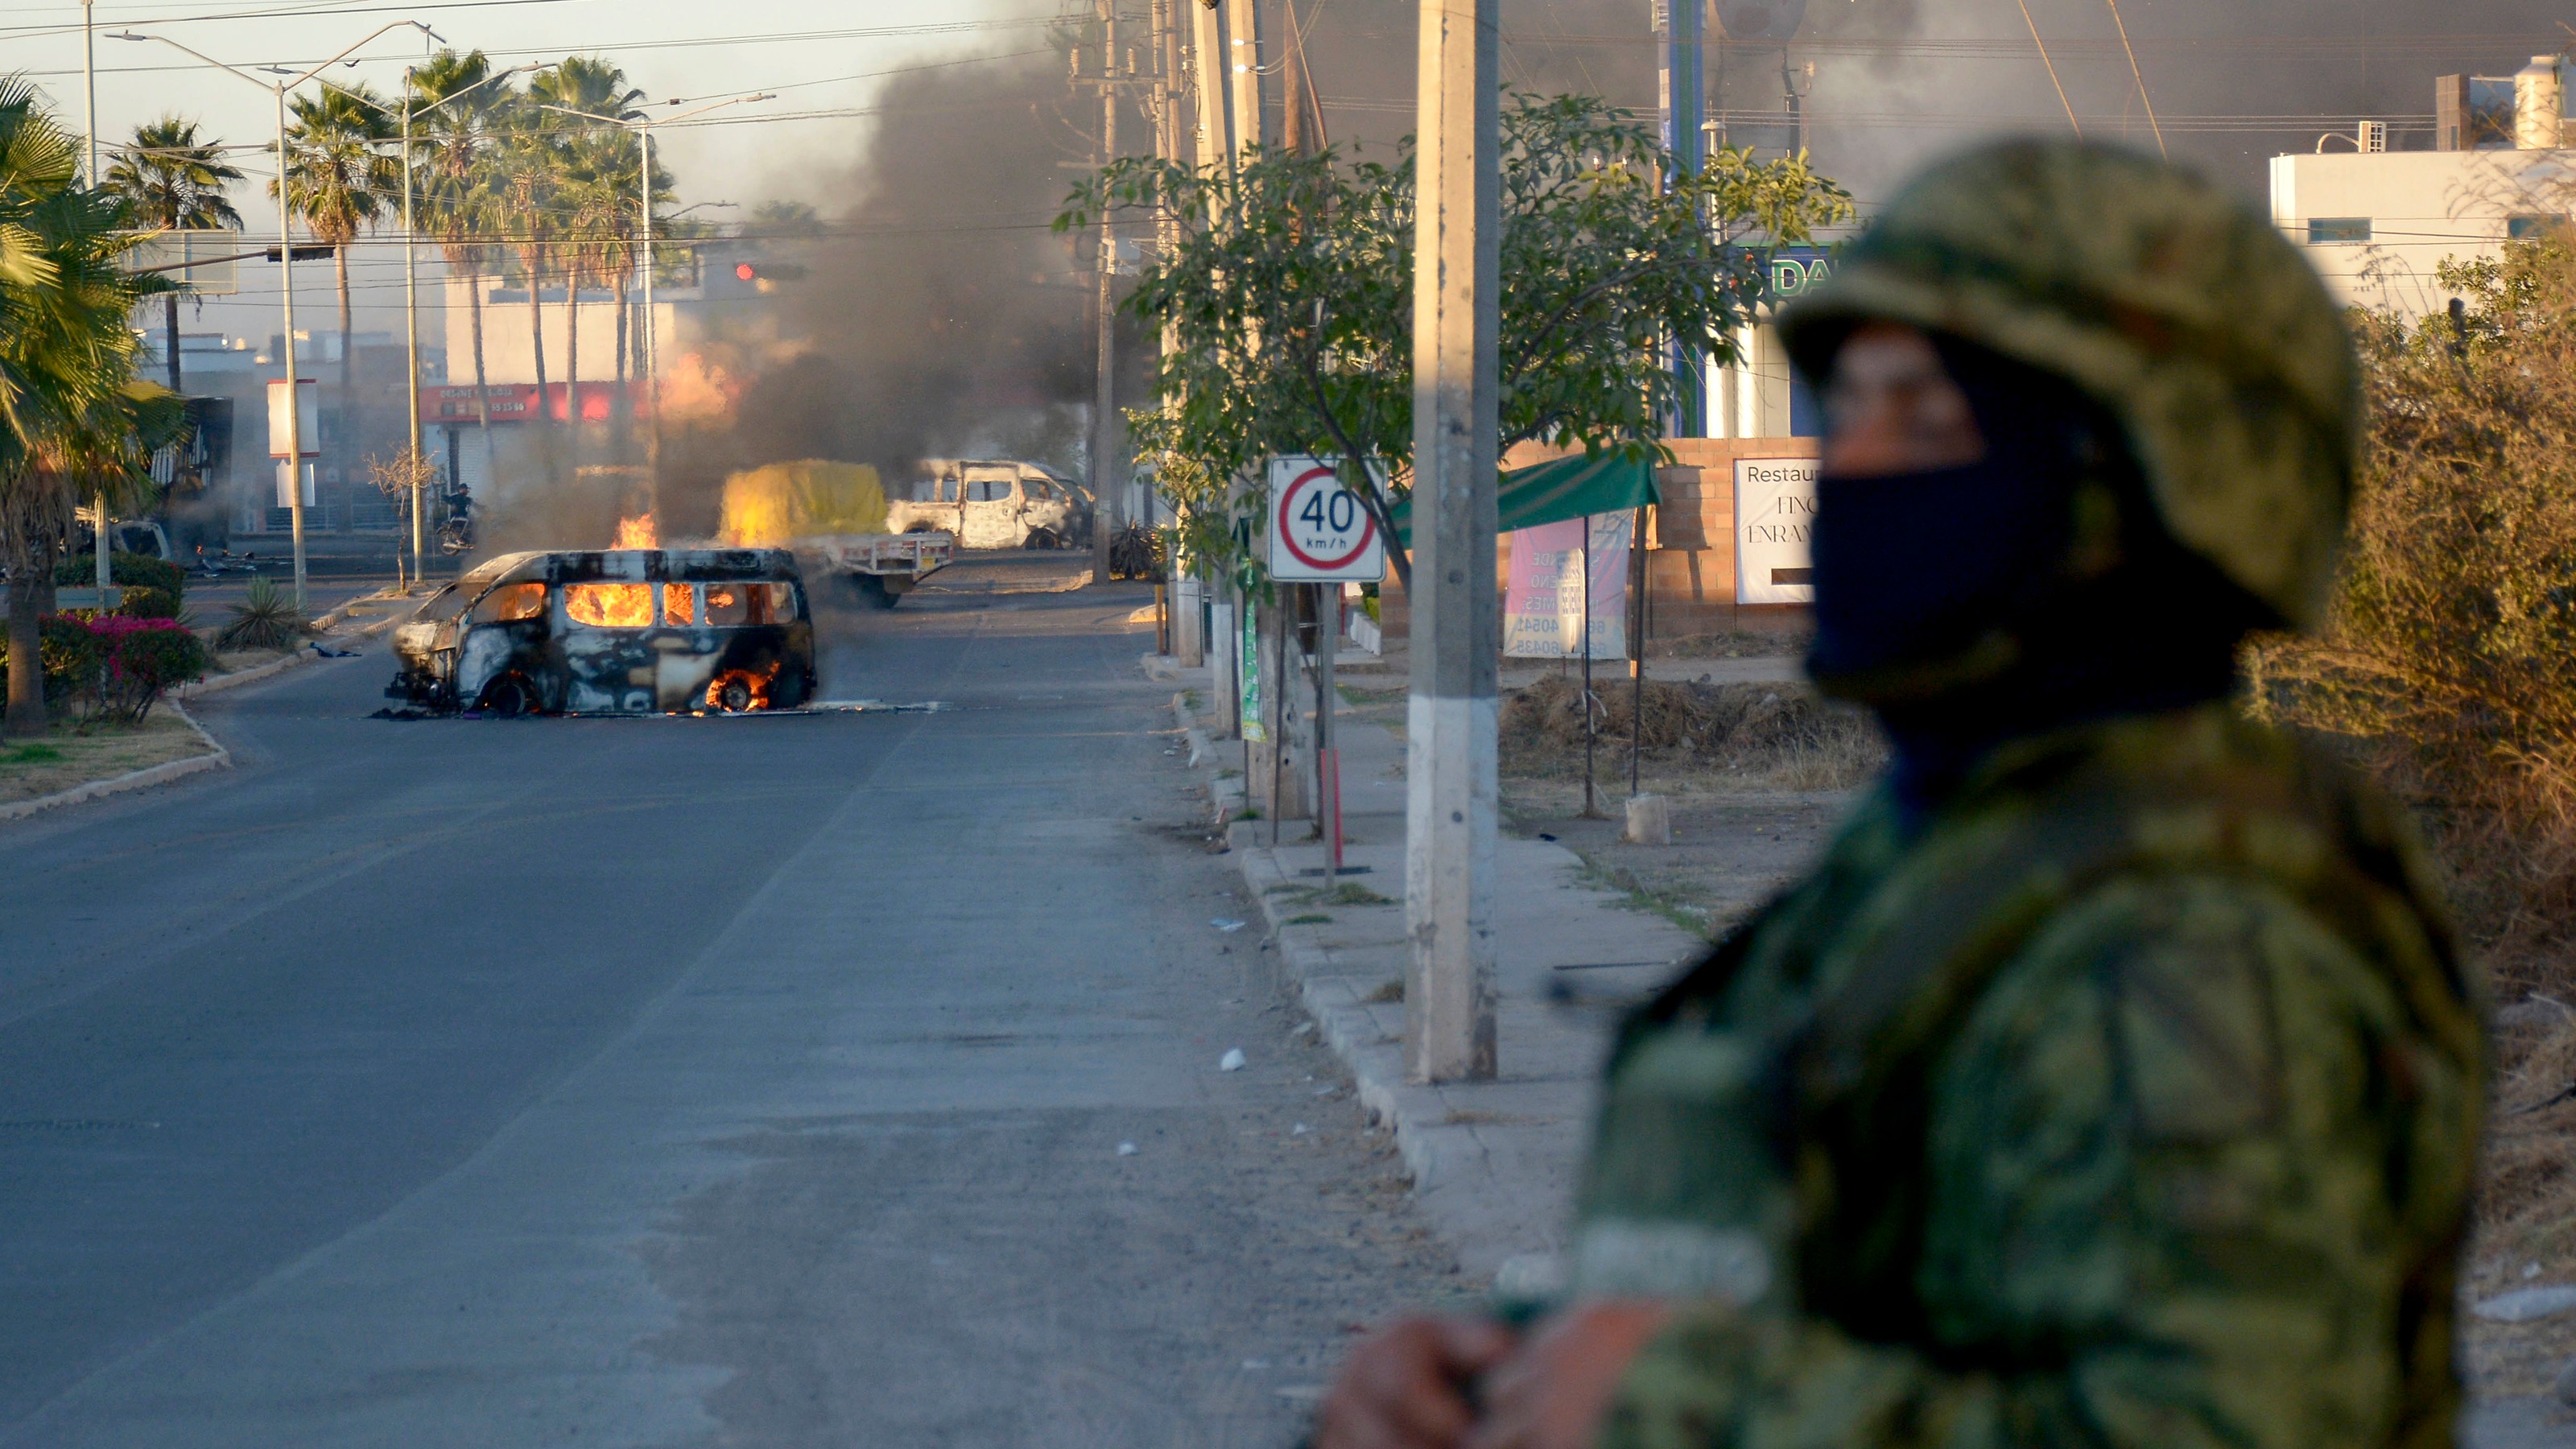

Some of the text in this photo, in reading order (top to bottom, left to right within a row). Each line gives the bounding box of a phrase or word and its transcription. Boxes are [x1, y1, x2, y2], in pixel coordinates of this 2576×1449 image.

[1771, 259, 1838, 297] DA
[1300, 489, 1355, 533] 40
[1307, 538, 1347, 549] km/h
